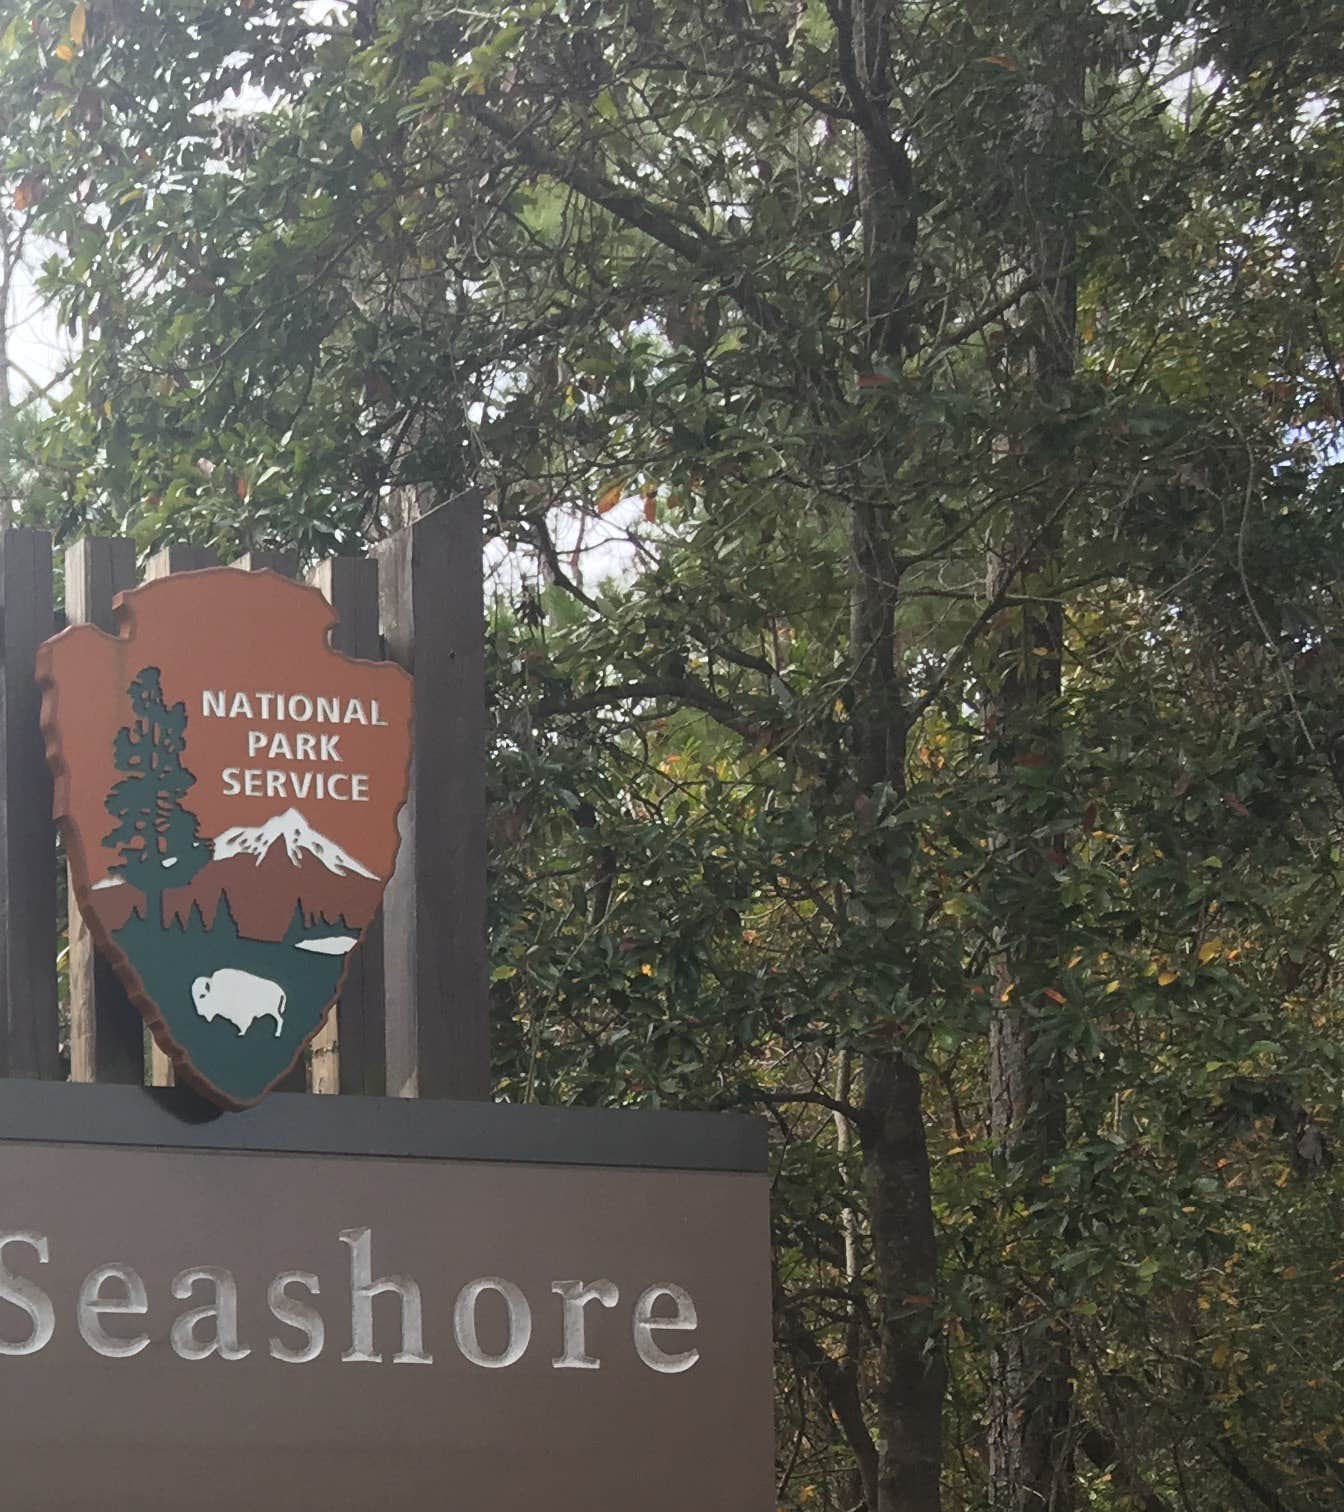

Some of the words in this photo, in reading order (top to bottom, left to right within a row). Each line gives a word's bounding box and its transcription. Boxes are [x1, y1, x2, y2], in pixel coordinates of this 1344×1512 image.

[201, 690, 389, 727] NATIONAL
[248, 731, 342, 762] PARK
[221, 768, 370, 802] SERVICE
